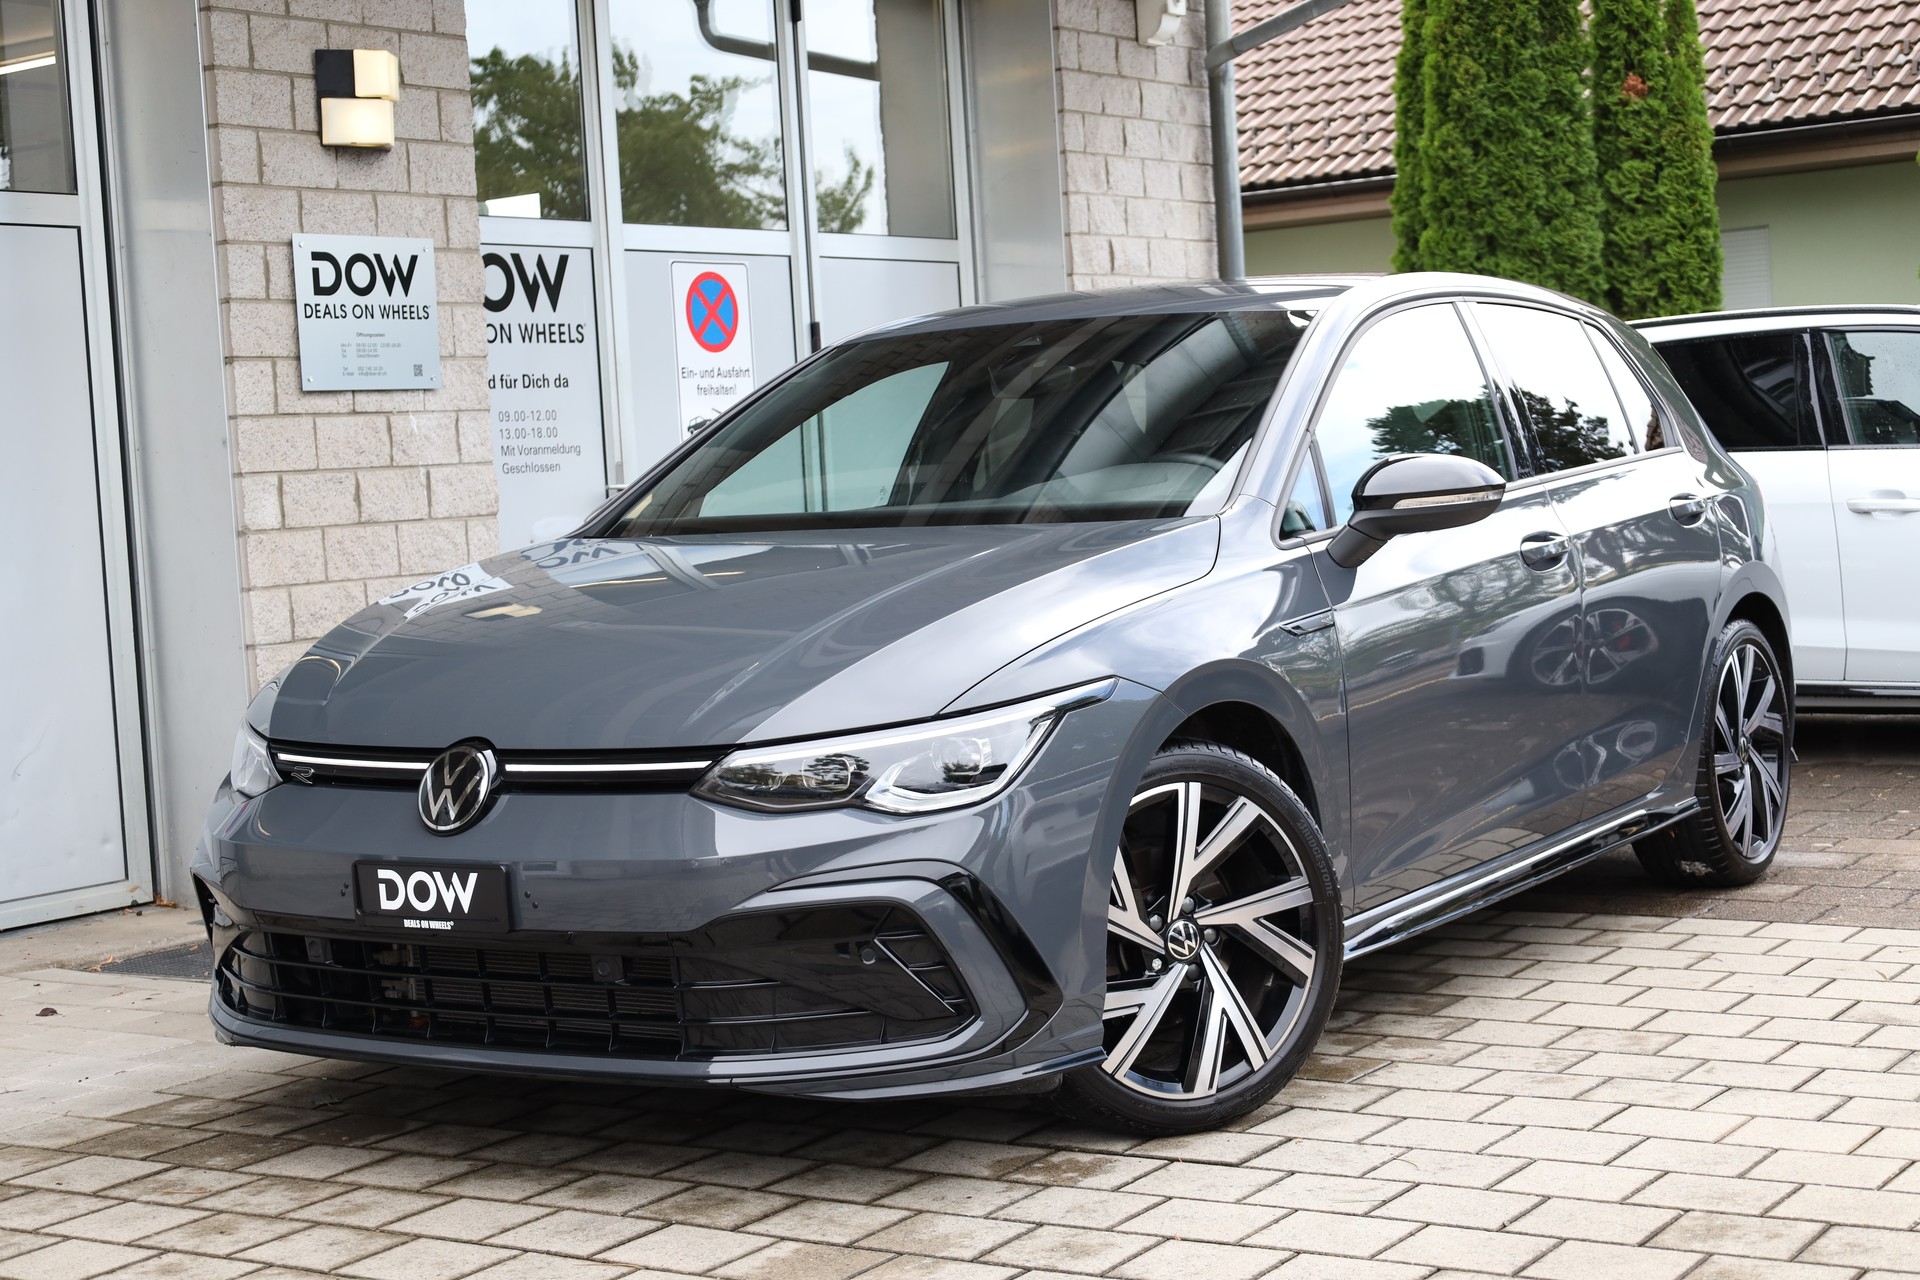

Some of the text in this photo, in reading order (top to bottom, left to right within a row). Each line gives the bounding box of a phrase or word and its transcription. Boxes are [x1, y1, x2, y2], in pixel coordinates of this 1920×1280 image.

[311, 251, 418, 297] DOW
[304, 303, 430, 320] DEALS ON WHEELS
[518, 323, 585, 344] WHEELS
[681, 366, 751, 378] Ein- und Ausfahrt
[500, 374, 518, 389] für
[522, 373, 550, 389] Dich
[554, 373, 569, 388] da
[697, 384, 737, 396] freihalten!
[498, 409, 557, 422] 09.00-12.00
[499, 427, 558, 440] 13.00-18.00
[501, 443, 581, 457] Mit Voranmeldung
[502, 462, 561, 475] Geschlossen
[1296, 819, 1335, 898] BRIDGESTONE
[377, 868, 478, 914] DOW
[403, 919, 421, 928] DEALS
